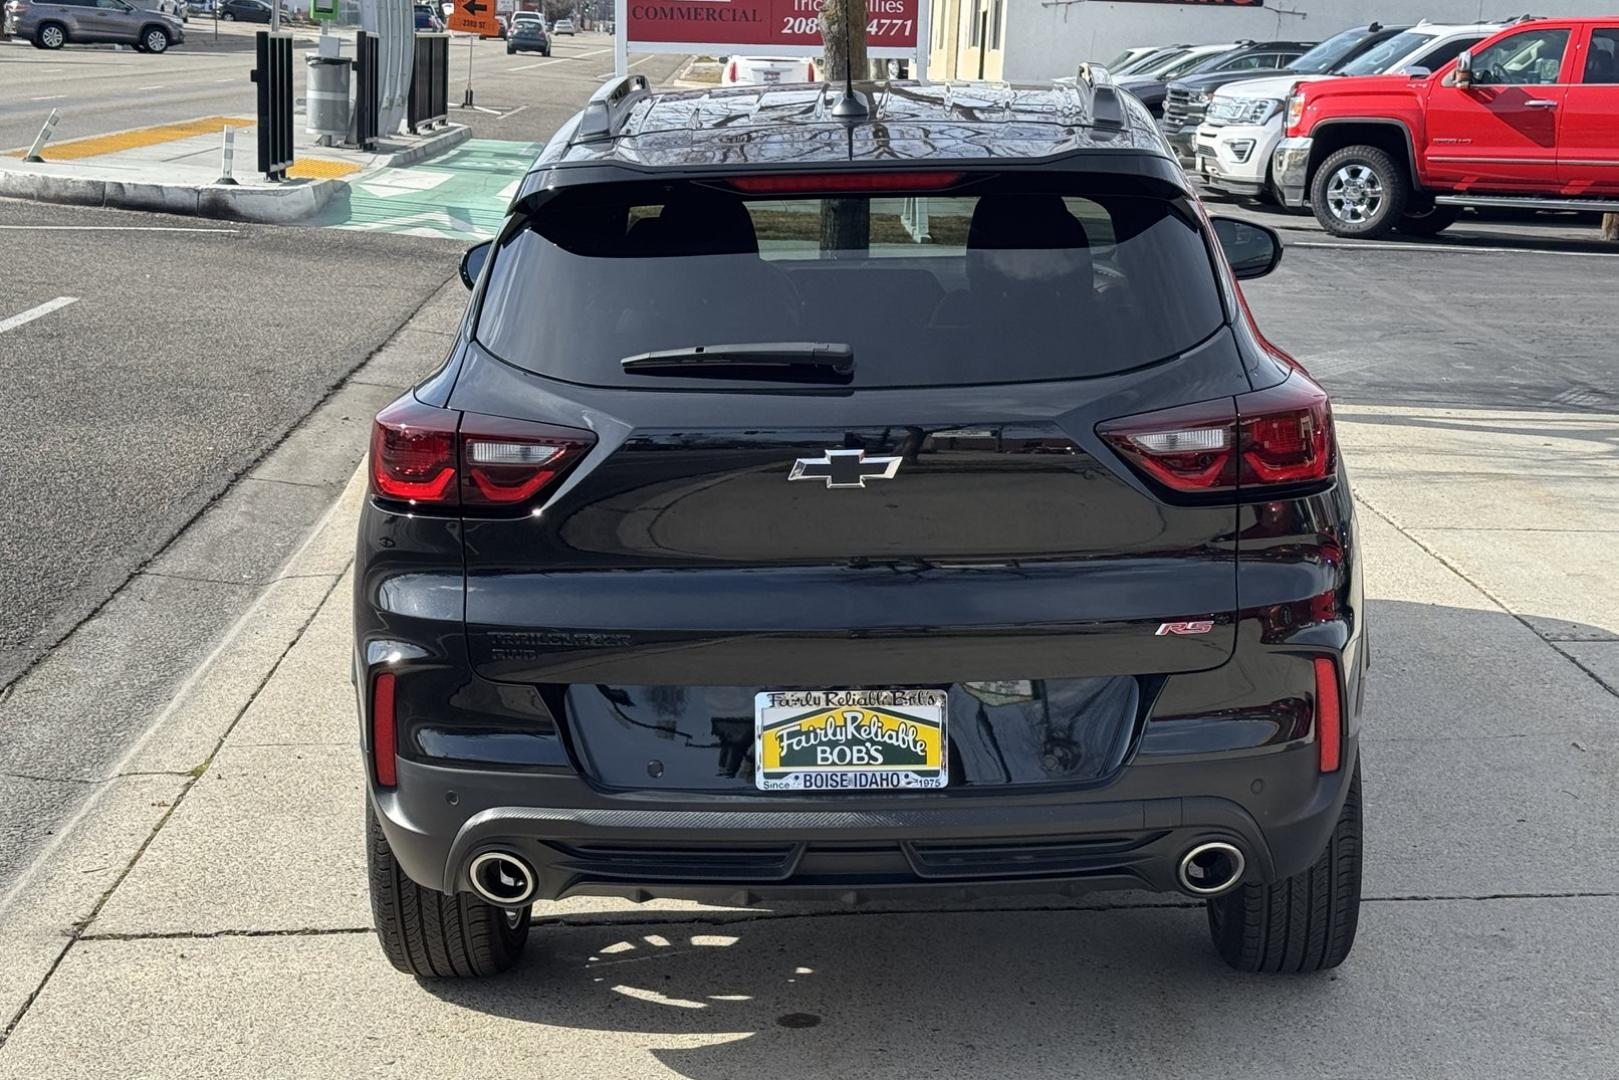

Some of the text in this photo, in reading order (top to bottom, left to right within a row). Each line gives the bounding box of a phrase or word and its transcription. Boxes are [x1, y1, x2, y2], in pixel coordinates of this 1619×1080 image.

[632, 5, 762, 22] COMMERCIAL
[1155, 620, 1214, 636] RS
[487, 631, 632, 647] TRAILBLAZER
[767, 691, 821, 708] Fairly
[823, 691, 888, 707] Reliable
[777, 711, 926, 757] Fairly Reliable
[816, 742, 884, 765] BOB'S
[763, 772, 941, 789] Since BOISE IDAHO 1975
